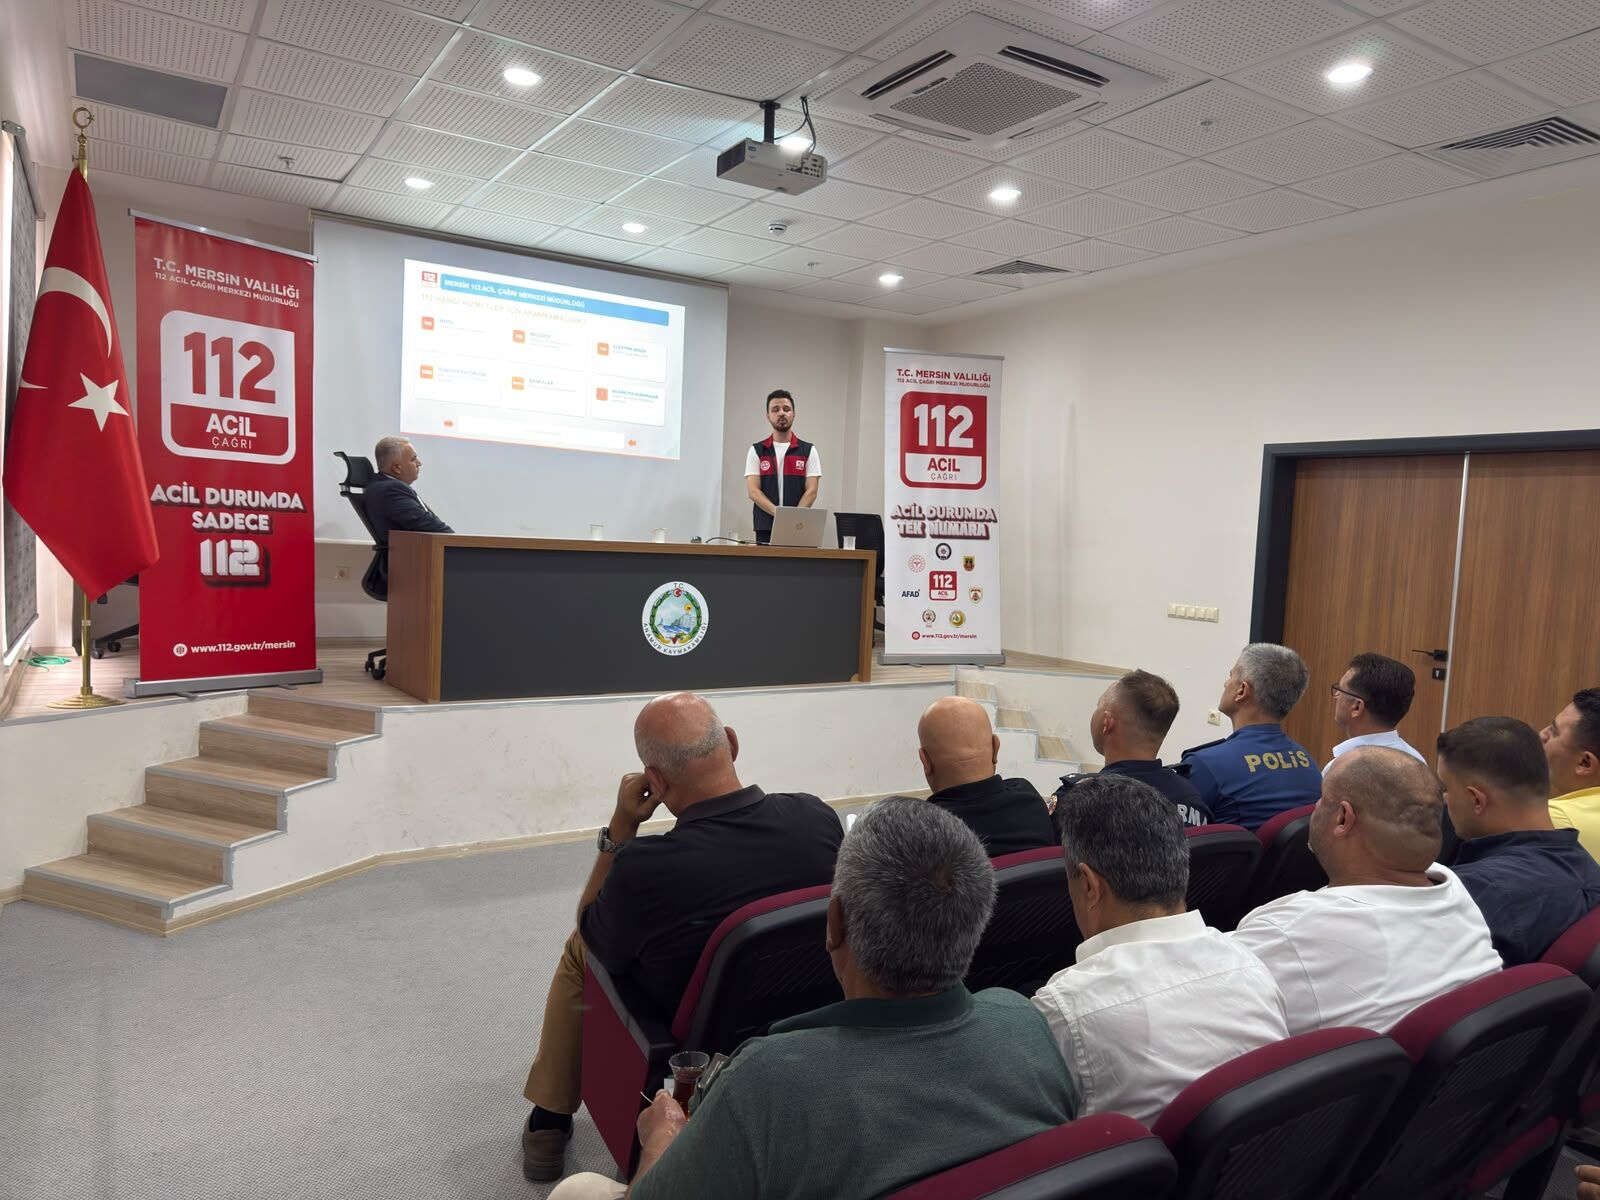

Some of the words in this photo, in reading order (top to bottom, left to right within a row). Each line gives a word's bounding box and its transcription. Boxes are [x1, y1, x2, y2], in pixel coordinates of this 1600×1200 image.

[154, 258, 181, 273] T.C.
[186, 264, 240, 286] MERSİN
[244, 277, 300, 299] VALİLİĞİ
[155, 271, 166, 280] 112
[190, 277, 215, 290] ÇAĞRI
[184, 331, 276, 404] 112
[897, 368, 913, 377] T.C.
[916, 369, 950, 379] MERSİN
[953, 372, 991, 382] VALİLİĞİ
[205, 413, 257, 437] ACİL
[914, 403, 974, 448] 112
[212, 436, 252, 449] ÇAĞRI
[927, 457, 960, 472] ACİL
[930, 472, 957, 481] ÇAĞRI
[150, 481, 201, 505] ACİL
[205, 487, 304, 510] DURUMDA
[191, 511, 270, 532] SADECE
[891, 503, 925, 520] ACİL
[927, 505, 997, 522] DURUMDA
[897, 521, 926, 538] TEK
[928, 522, 990, 540] NUMARA
[200, 538, 261, 576] 112
[933, 574, 953, 588] 112
[901, 590, 920, 598] AFAD
[643, 622, 662, 650] ANAMUR
[191, 640, 296, 654] www.112.gov.tr/mersin
[1244, 750, 1310, 772] POLİS
